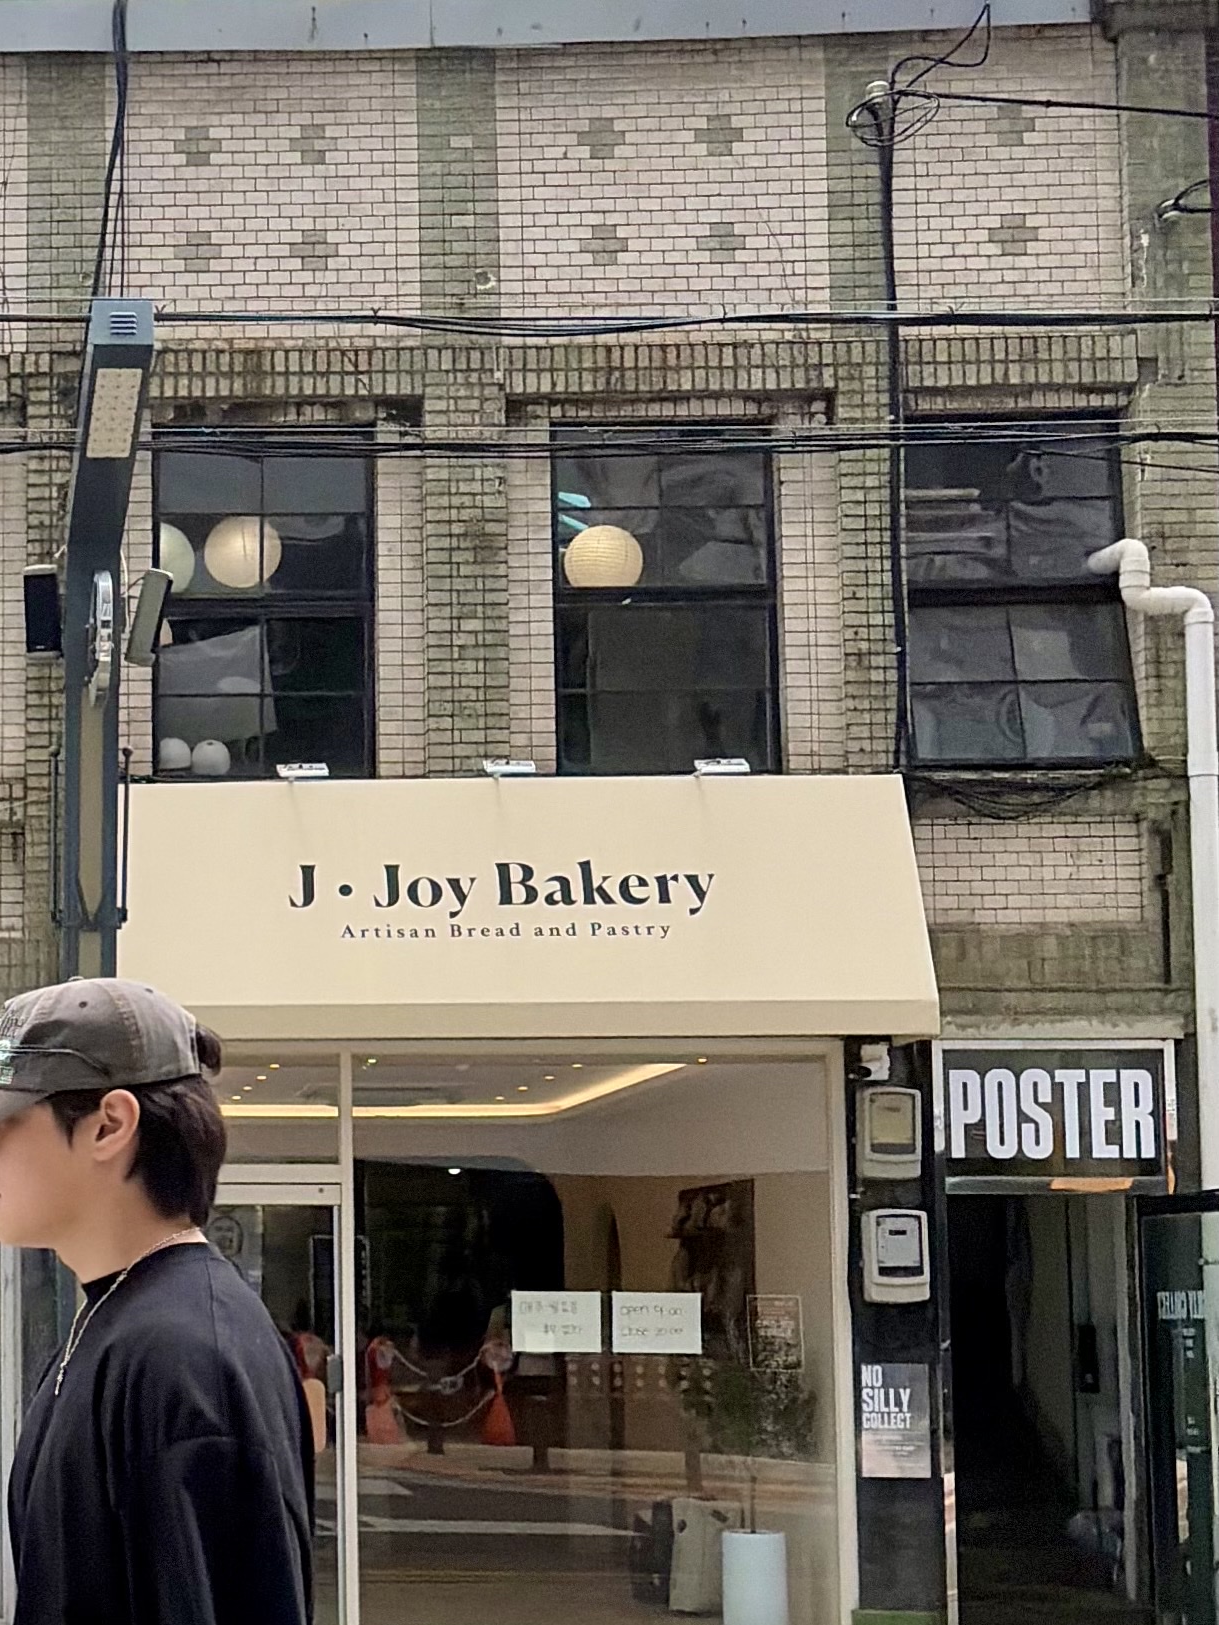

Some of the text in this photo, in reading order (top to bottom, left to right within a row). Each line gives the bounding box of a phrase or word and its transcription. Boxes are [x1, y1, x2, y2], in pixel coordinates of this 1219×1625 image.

[289, 864, 316, 908] J
[373, 864, 477, 919] Joy
[494, 859, 715, 916] Bakery
[341, 922, 671, 939] Artisan Bread and Pastry
[948, 1068, 1156, 1160] POSTER
[861, 1365, 883, 1387] NO
[862, 1387, 911, 1413] SILLY
[862, 1412, 911, 1429] COLLECT
